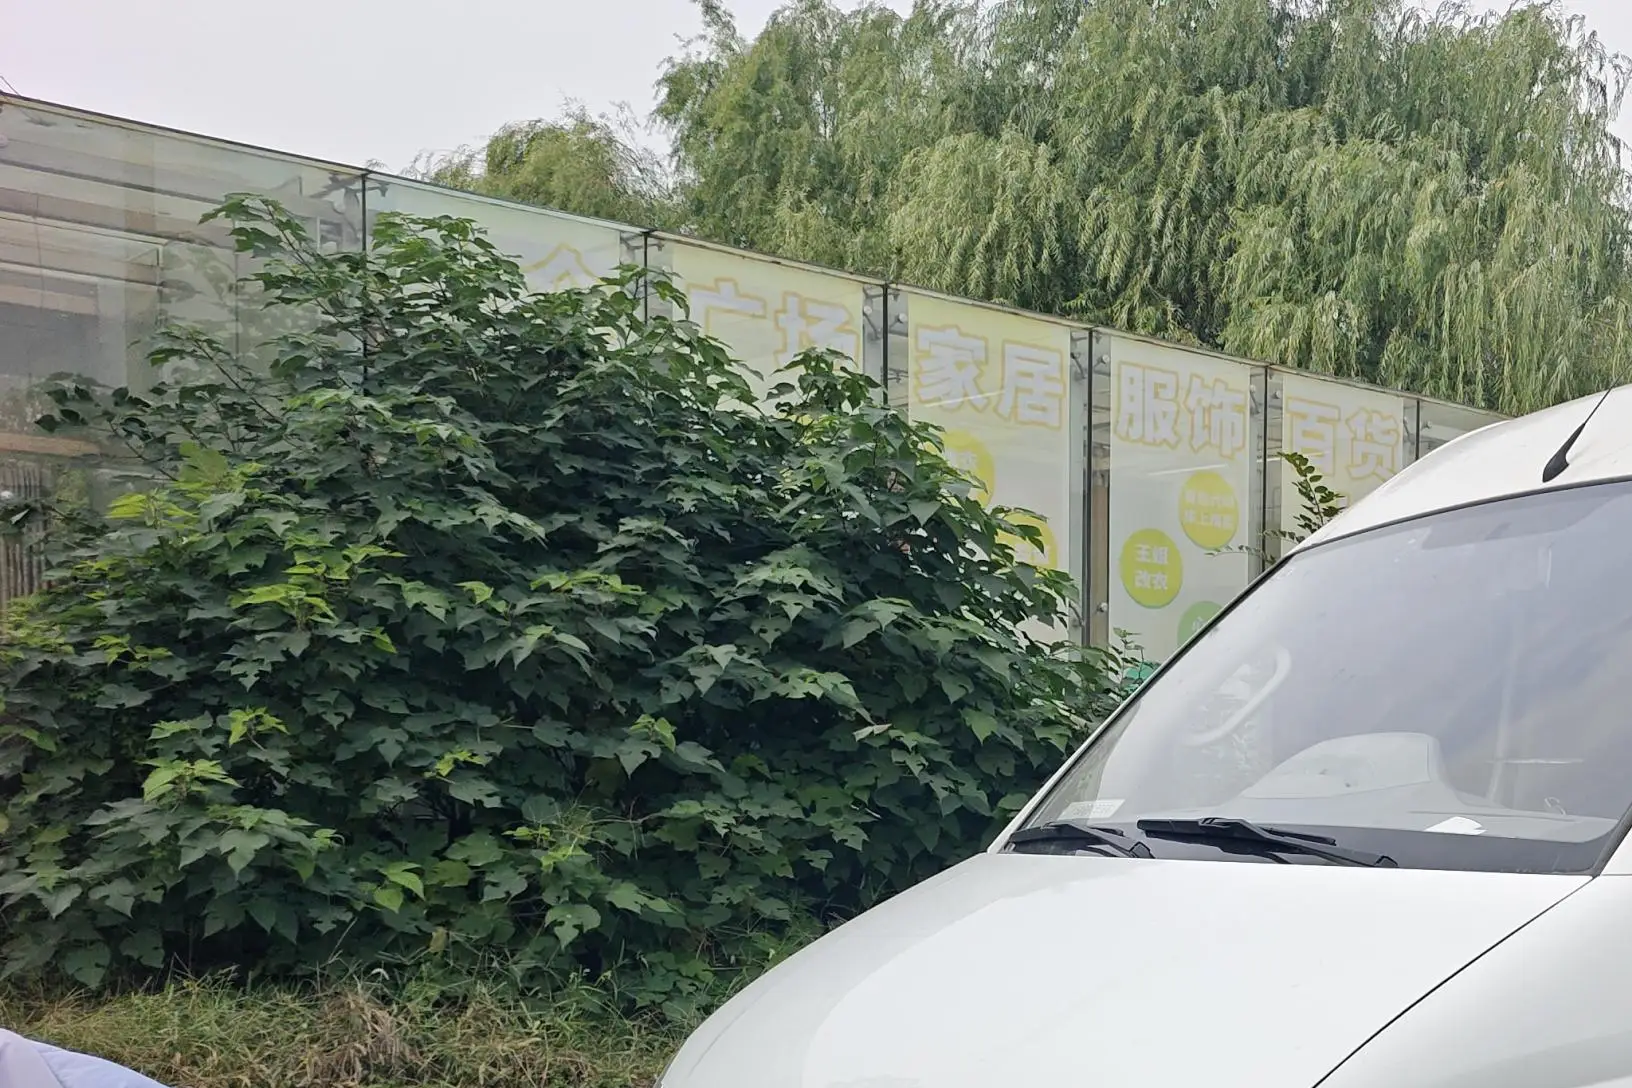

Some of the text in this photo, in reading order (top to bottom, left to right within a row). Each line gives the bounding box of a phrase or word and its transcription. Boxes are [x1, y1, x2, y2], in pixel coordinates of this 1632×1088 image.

[915, 324, 1066, 430] 家居
[1114, 361, 1246, 459] 服饰
[1286, 396, 1399, 480] 百货
